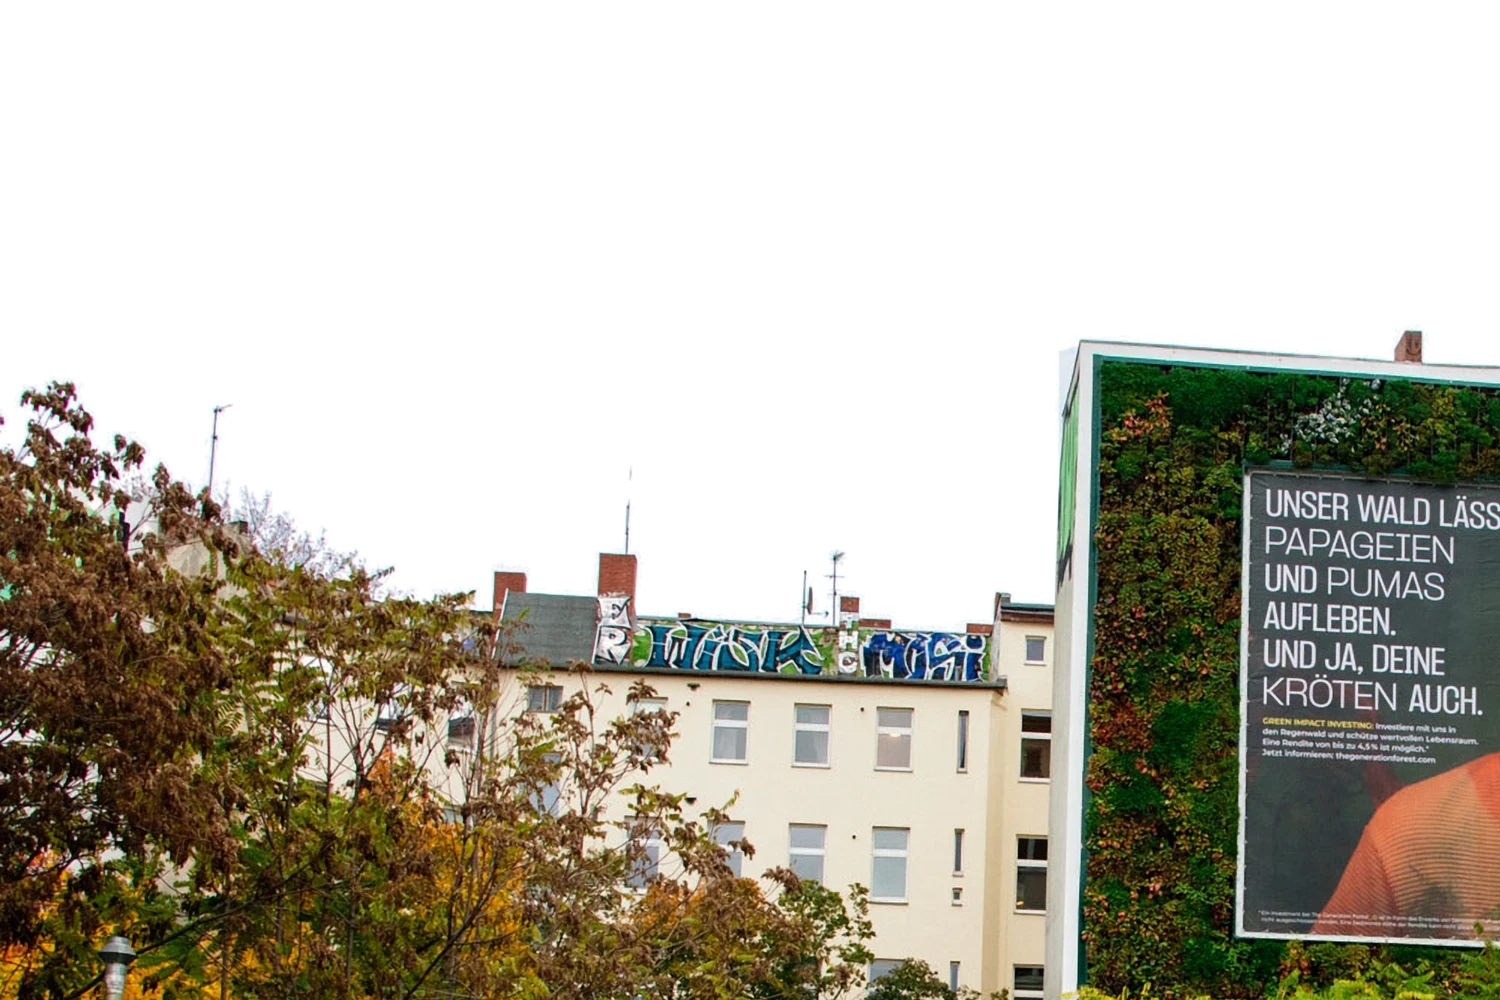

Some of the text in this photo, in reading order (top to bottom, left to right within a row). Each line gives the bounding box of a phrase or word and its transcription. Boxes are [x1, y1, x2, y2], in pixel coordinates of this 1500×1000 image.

[1266, 488, 1349, 522] UNSER
[1357, 494, 1430, 526] WALD
[1265, 526, 1454, 564] PAPAGEIEN
[1265, 564, 1445, 601] UND PUMAS
[1263, 601, 1396, 636] AUFLEBEN.
[1263, 640, 1445, 676] UND JA, DEINE
[1263, 674, 1483, 716] KRÖTEN AUCH.
[1263, 717, 1291, 725] GREEN
[1294, 719, 1325, 727] IMPACT
[1327, 720, 1374, 730] INVESTING:
[1376, 723, 1414, 731] Investiere
[1416, 724, 1430, 732] mit
[1263, 728, 1479, 745] den Regenwald und schütze wertvollen Lebensraum.
[1262, 748, 1436, 764] Jetzt informieren: thegenerationforest.com
[1282, 739, 1313, 747] Rendite
[1333, 741, 1344, 749] bis
[1380, 743, 1390, 751] ist
